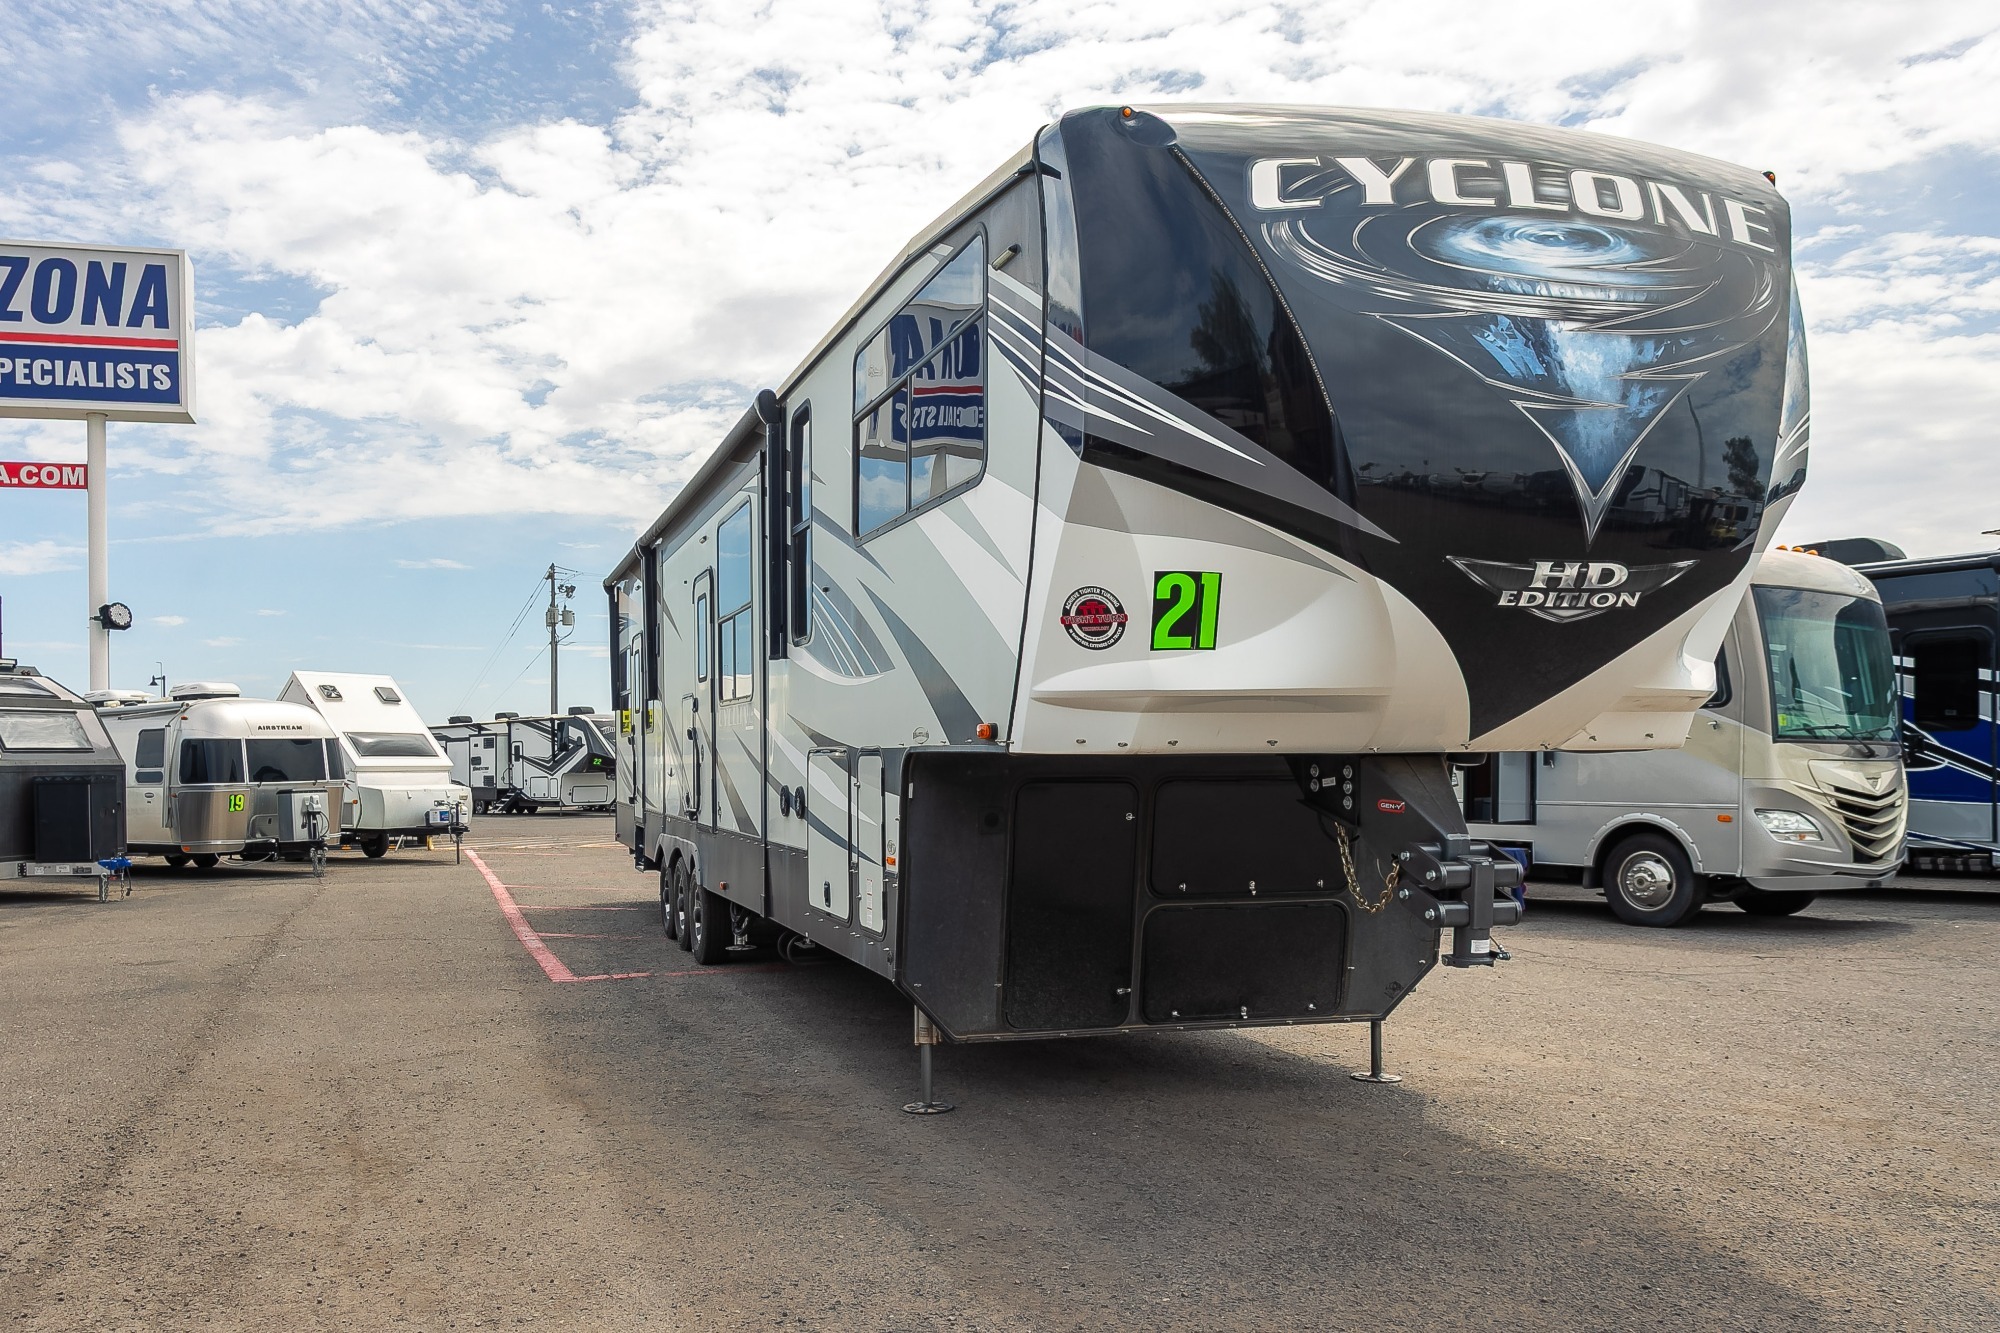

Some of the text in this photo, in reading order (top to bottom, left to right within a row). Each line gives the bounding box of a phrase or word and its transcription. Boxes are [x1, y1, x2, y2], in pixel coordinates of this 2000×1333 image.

[1250, 156, 1776, 253] CYCLONE
[0, 255, 170, 330] ZONA
[0, 357, 172, 391] PECIALISTS
[1528, 561, 1629, 589] HD
[1079, 587, 1101, 595] TIGHTER
[1101, 589, 1120, 608] TURNING
[1498, 590, 1642, 608] EDITION
[1063, 613, 1126, 625] TIGHT TURN
[1154, 572, 1220, 649] 21
[229, 794, 245, 812] 19
[1380, 801, 1405, 810] GEN-Y
